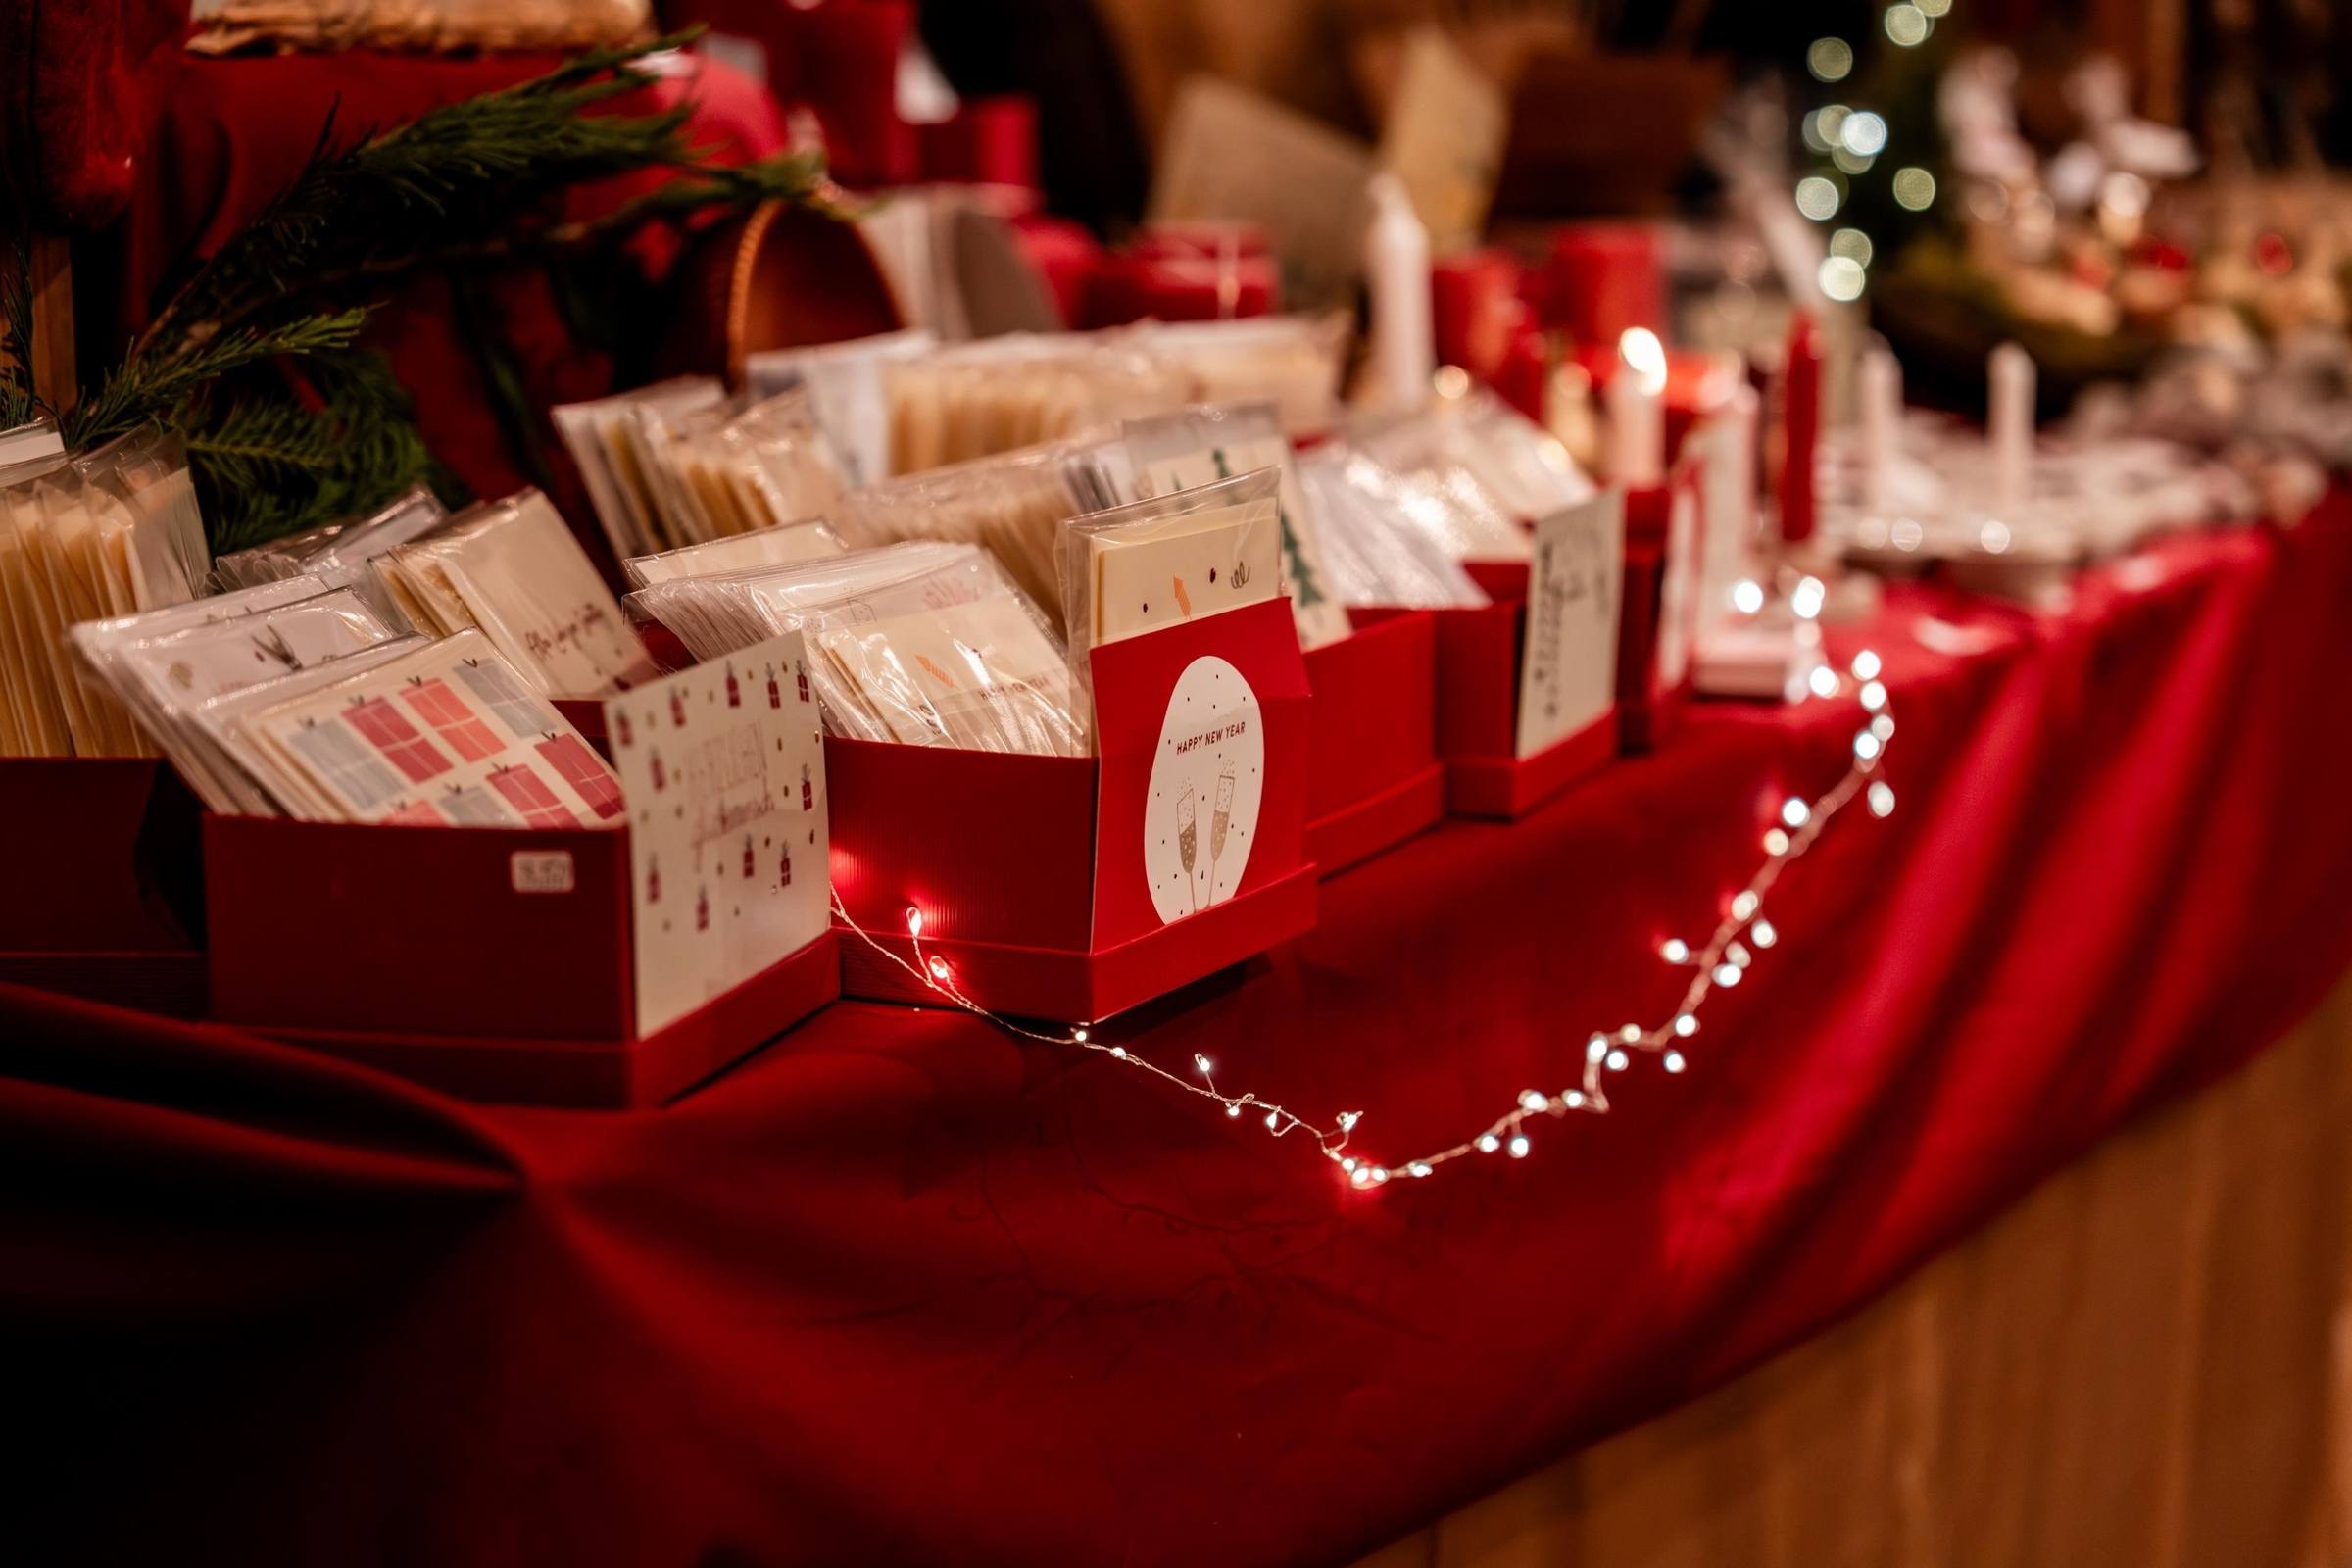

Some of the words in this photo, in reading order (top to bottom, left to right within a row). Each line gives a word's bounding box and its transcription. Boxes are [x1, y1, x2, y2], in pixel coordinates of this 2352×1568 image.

[1176, 735, 1203, 755] HAPPY
[1205, 728, 1223, 746] NEW
[1225, 721, 1246, 739] YEAR
